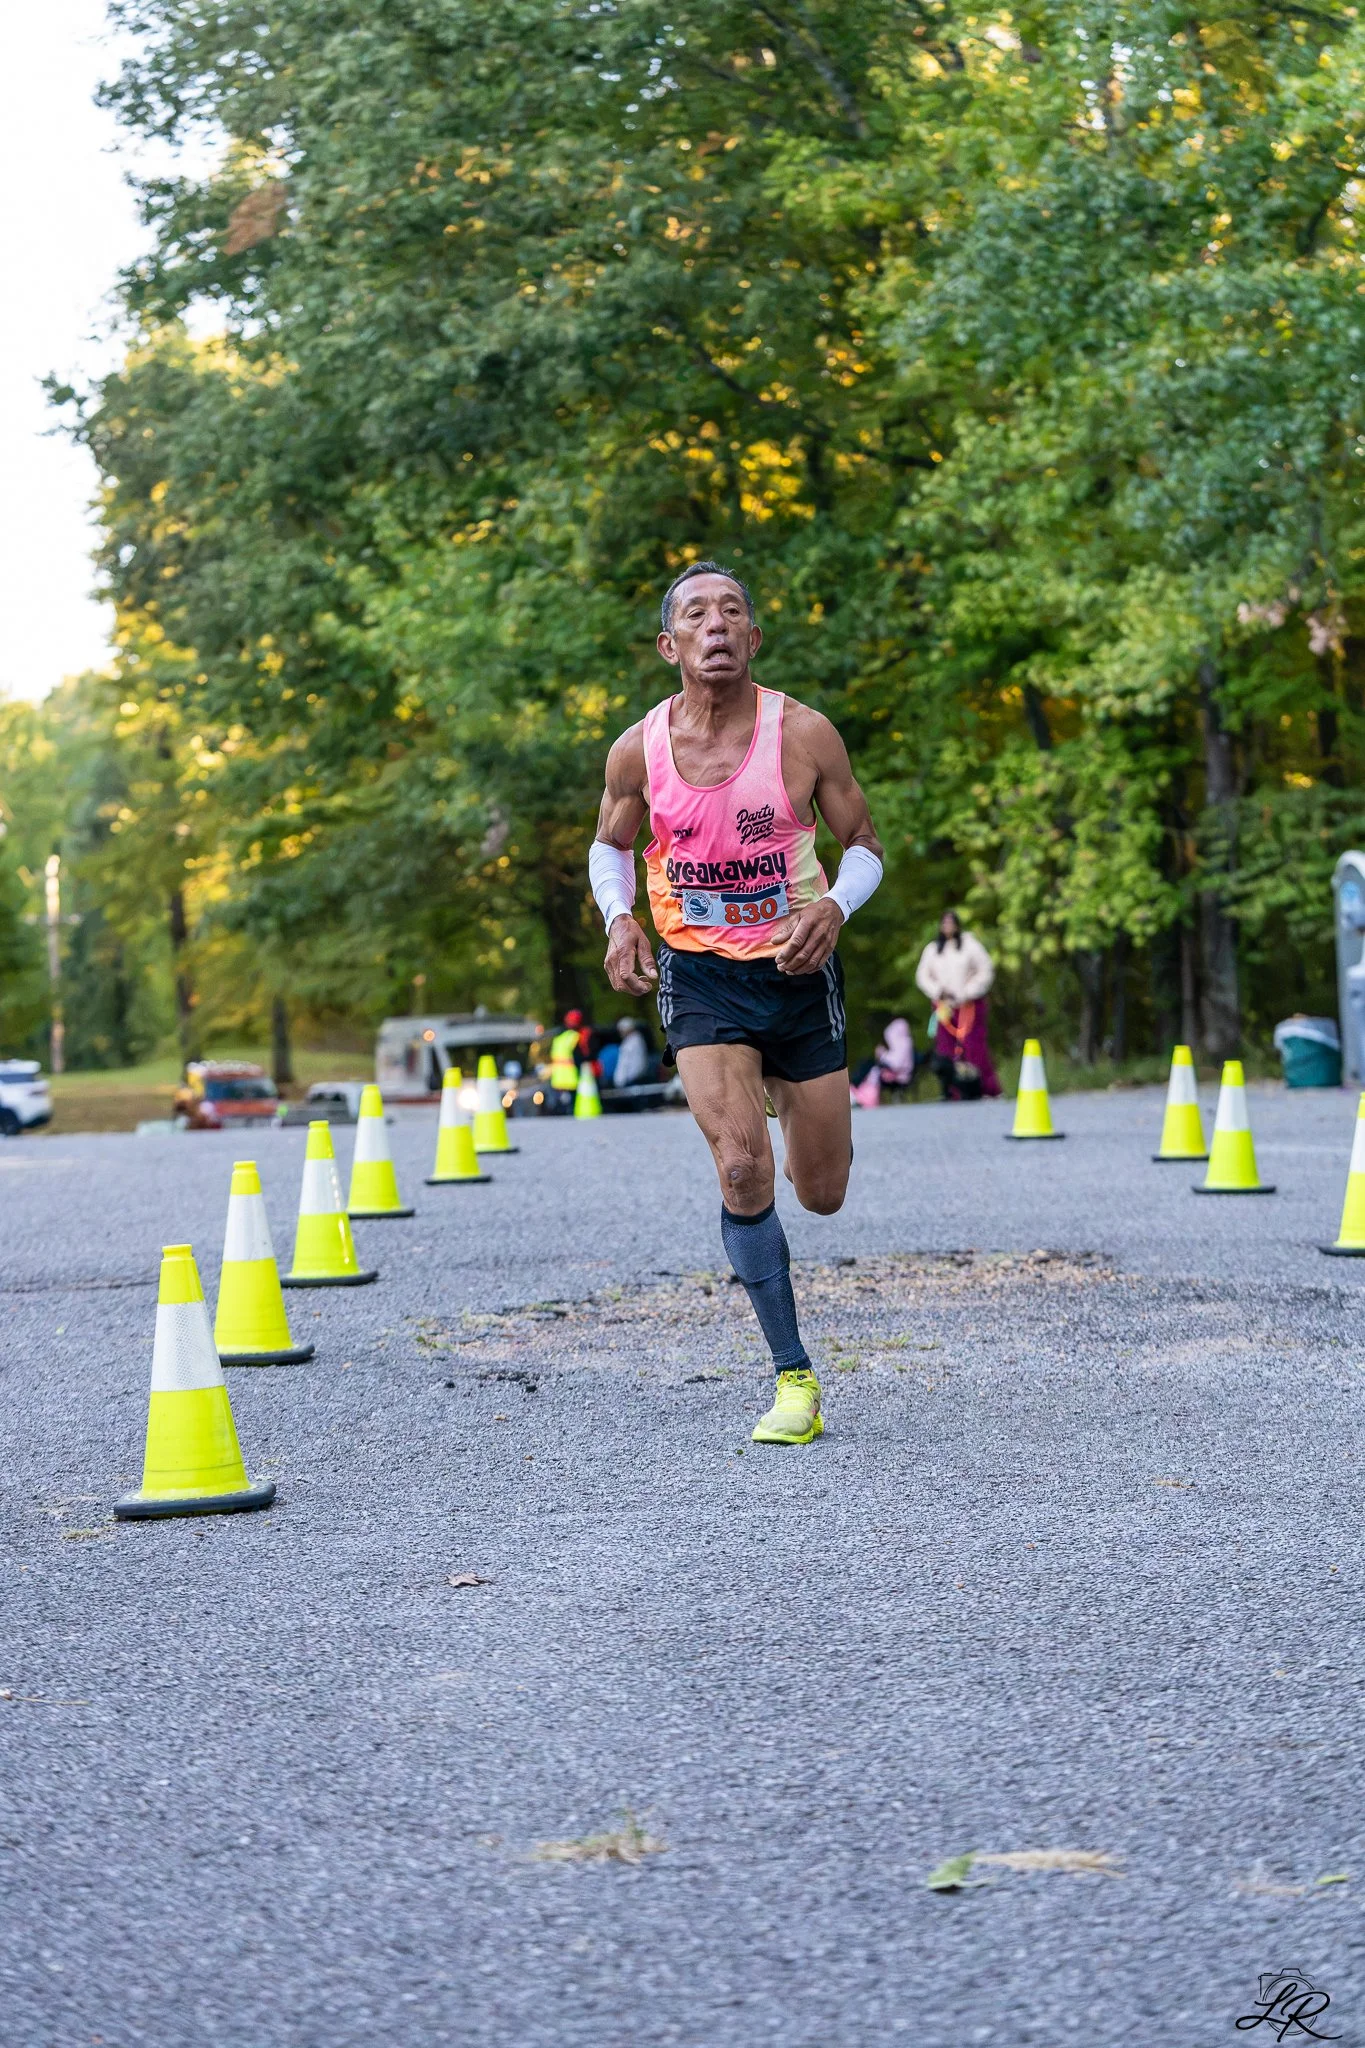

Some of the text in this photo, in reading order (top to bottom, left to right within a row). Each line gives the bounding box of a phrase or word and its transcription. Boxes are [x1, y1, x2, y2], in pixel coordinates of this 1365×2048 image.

[736, 804, 775, 831] Party
[739, 822, 775, 845] Pace
[666, 852, 787, 884] Breakaway
[734, 877, 793, 893] Runnig
[724, 898, 778, 925] 830
